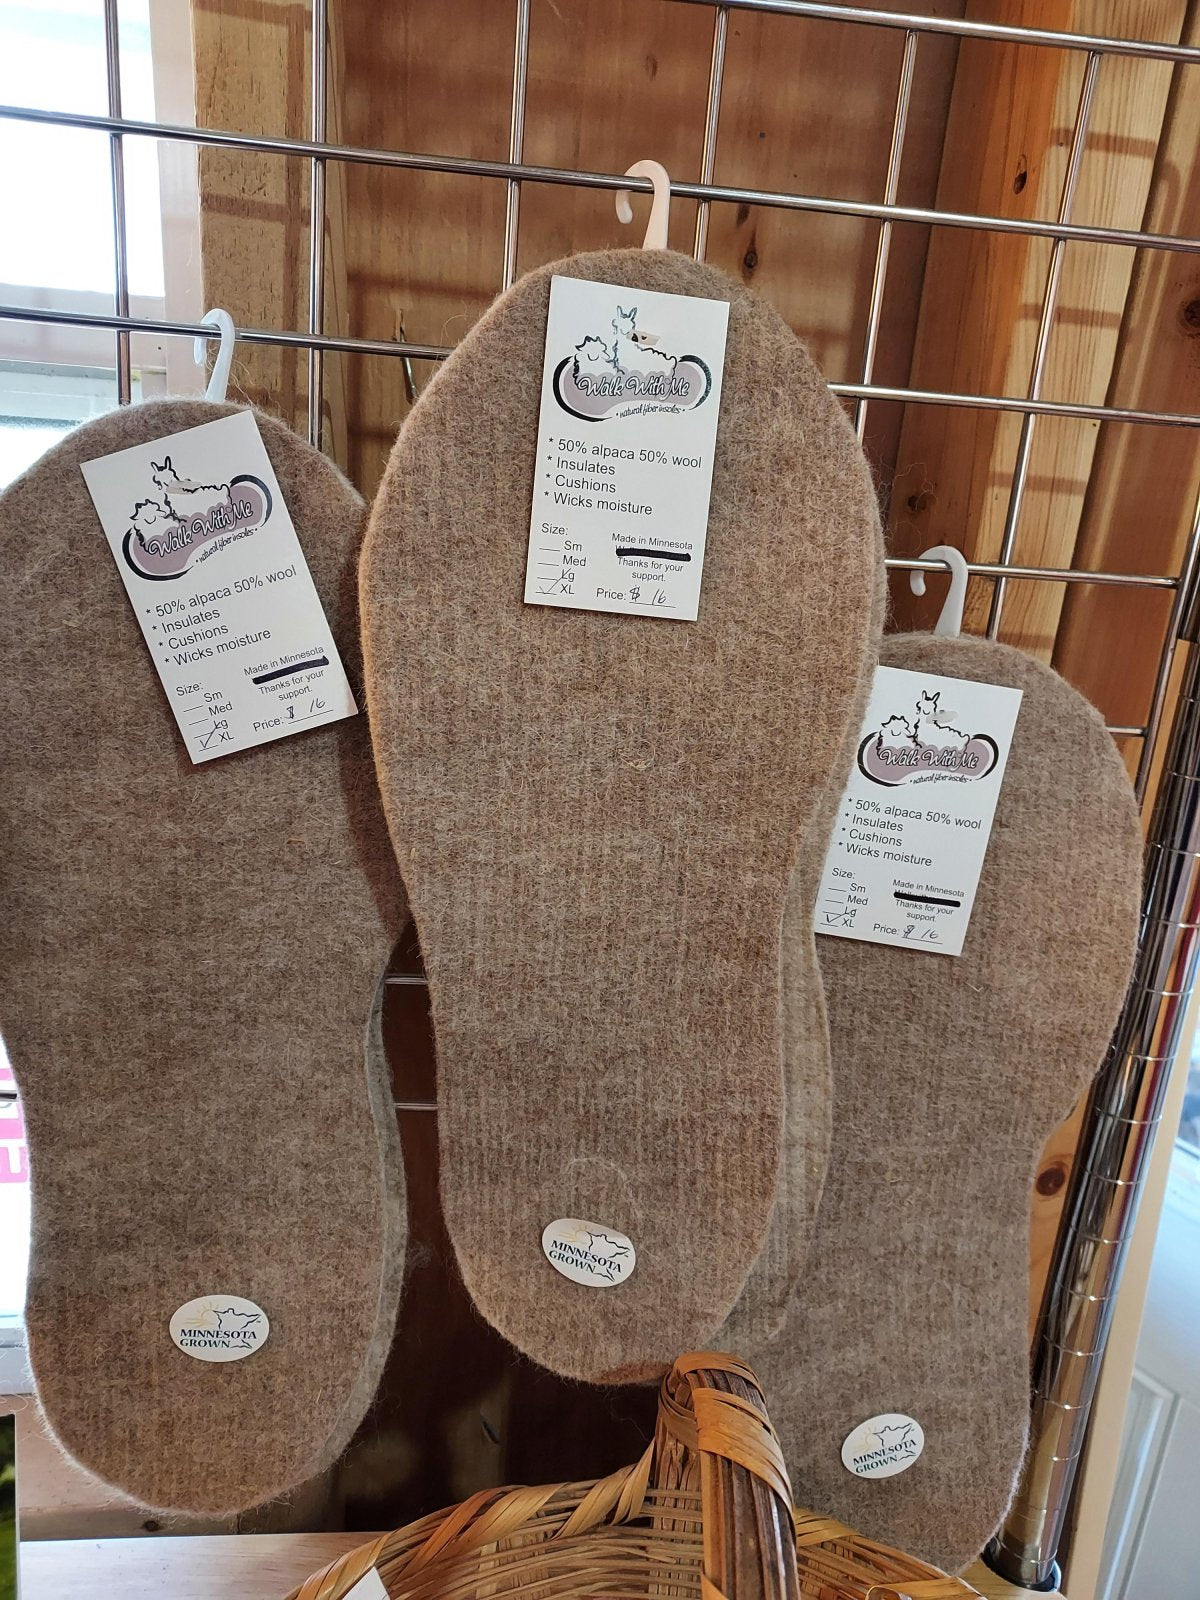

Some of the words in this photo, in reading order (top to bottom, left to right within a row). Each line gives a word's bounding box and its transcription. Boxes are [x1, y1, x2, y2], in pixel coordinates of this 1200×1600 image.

[578, 376, 624, 396] Walk
[625, 375, 665, 396] With
[659, 377, 690, 400] Me
[619, 404, 642, 418] natural
[643, 404, 657, 416] fiber
[658, 404, 680, 413] insoles
[558, 439, 587, 454] 50%
[592, 444, 635, 459] alpaca
[639, 450, 668, 464] 50%
[672, 456, 702, 468] wool
[557, 457, 616, 475] Insulates
[555, 475, 616, 493] Cushions
[554, 492, 593, 508] Wicks
[597, 500, 653, 515] moisture
[148, 526, 193, 557] Walk
[192, 506, 231, 536] With
[228, 501, 253, 530] Me
[541, 523, 569, 535] Size:
[198, 539, 218, 564] natural
[218, 536, 232, 551] fiber
[564, 541, 582, 551] Sm
[612, 533, 637, 544] Made
[638, 536, 646, 545] in
[648, 538, 693, 550] Minnesota
[563, 555, 586, 566] Med
[617, 557, 648, 568] Thanks
[651, 561, 663, 570] for
[664, 564, 684, 572] your
[561, 569, 575, 582] Lg
[632, 572, 666, 582] support.
[156, 599, 186, 616] 50%
[189, 587, 231, 608] alpaca
[234, 575, 263, 593] 50%
[266, 565, 297, 584] wool
[560, 584, 574, 594] XL
[596, 588, 627, 600] Price:
[652, 589, 666, 605] 16
[162, 609, 220, 633] Insulates
[168, 624, 229, 650] Cushions
[174, 647, 213, 666] Wicks
[217, 630, 271, 654] moisture
[244, 664, 269, 676] Made
[270, 658, 279, 668] in
[280, 646, 324, 666] Minnesota
[176, 683, 203, 697] Size:
[259, 680, 291, 695] Thanks
[292, 676, 304, 685] for
[305, 669, 325, 683] your
[204, 690, 223, 702] Sm
[278, 687, 313, 701] support.
[209, 702, 233, 716] Med
[253, 717, 284, 732] Price:
[309, 698, 325, 713] 16
[218, 731, 235, 742] XL
[880, 748, 920, 766] Walk
[921, 749, 956, 766] With
[950, 752, 979, 772] Me
[852, 814, 904, 832] Insulates
[856, 800, 880, 813] 50%
[884, 805, 922, 820] alpaca
[926, 812, 951, 824] 50%
[954, 817, 982, 829] wool
[849, 828, 902, 846] Cushions
[846, 842, 880, 858] Wicks
[883, 850, 932, 866] moisture
[832, 868, 855, 879] Size:
[850, 883, 866, 893] Sm
[893, 880, 914, 889] Made
[925, 884, 965, 898] Minnesota
[847, 895, 868, 906] Med
[895, 899, 923, 910] Thanks
[925, 903, 935, 911] for
[936, 906, 954, 915] your
[844, 907, 856, 917] Lg
[842, 918, 854, 928] XL
[873, 924, 900, 936] Price:
[921, 929, 939, 939] 16
[549, 1250, 595, 1273] GROWN
[551, 1240, 621, 1273] MINNESOTA
[180, 1329, 257, 1339] MINNESOTA
[180, 1339, 230, 1348] GROWN
[853, 1440, 916, 1465] MINNESOTA
[856, 1455, 897, 1473] GROWN
